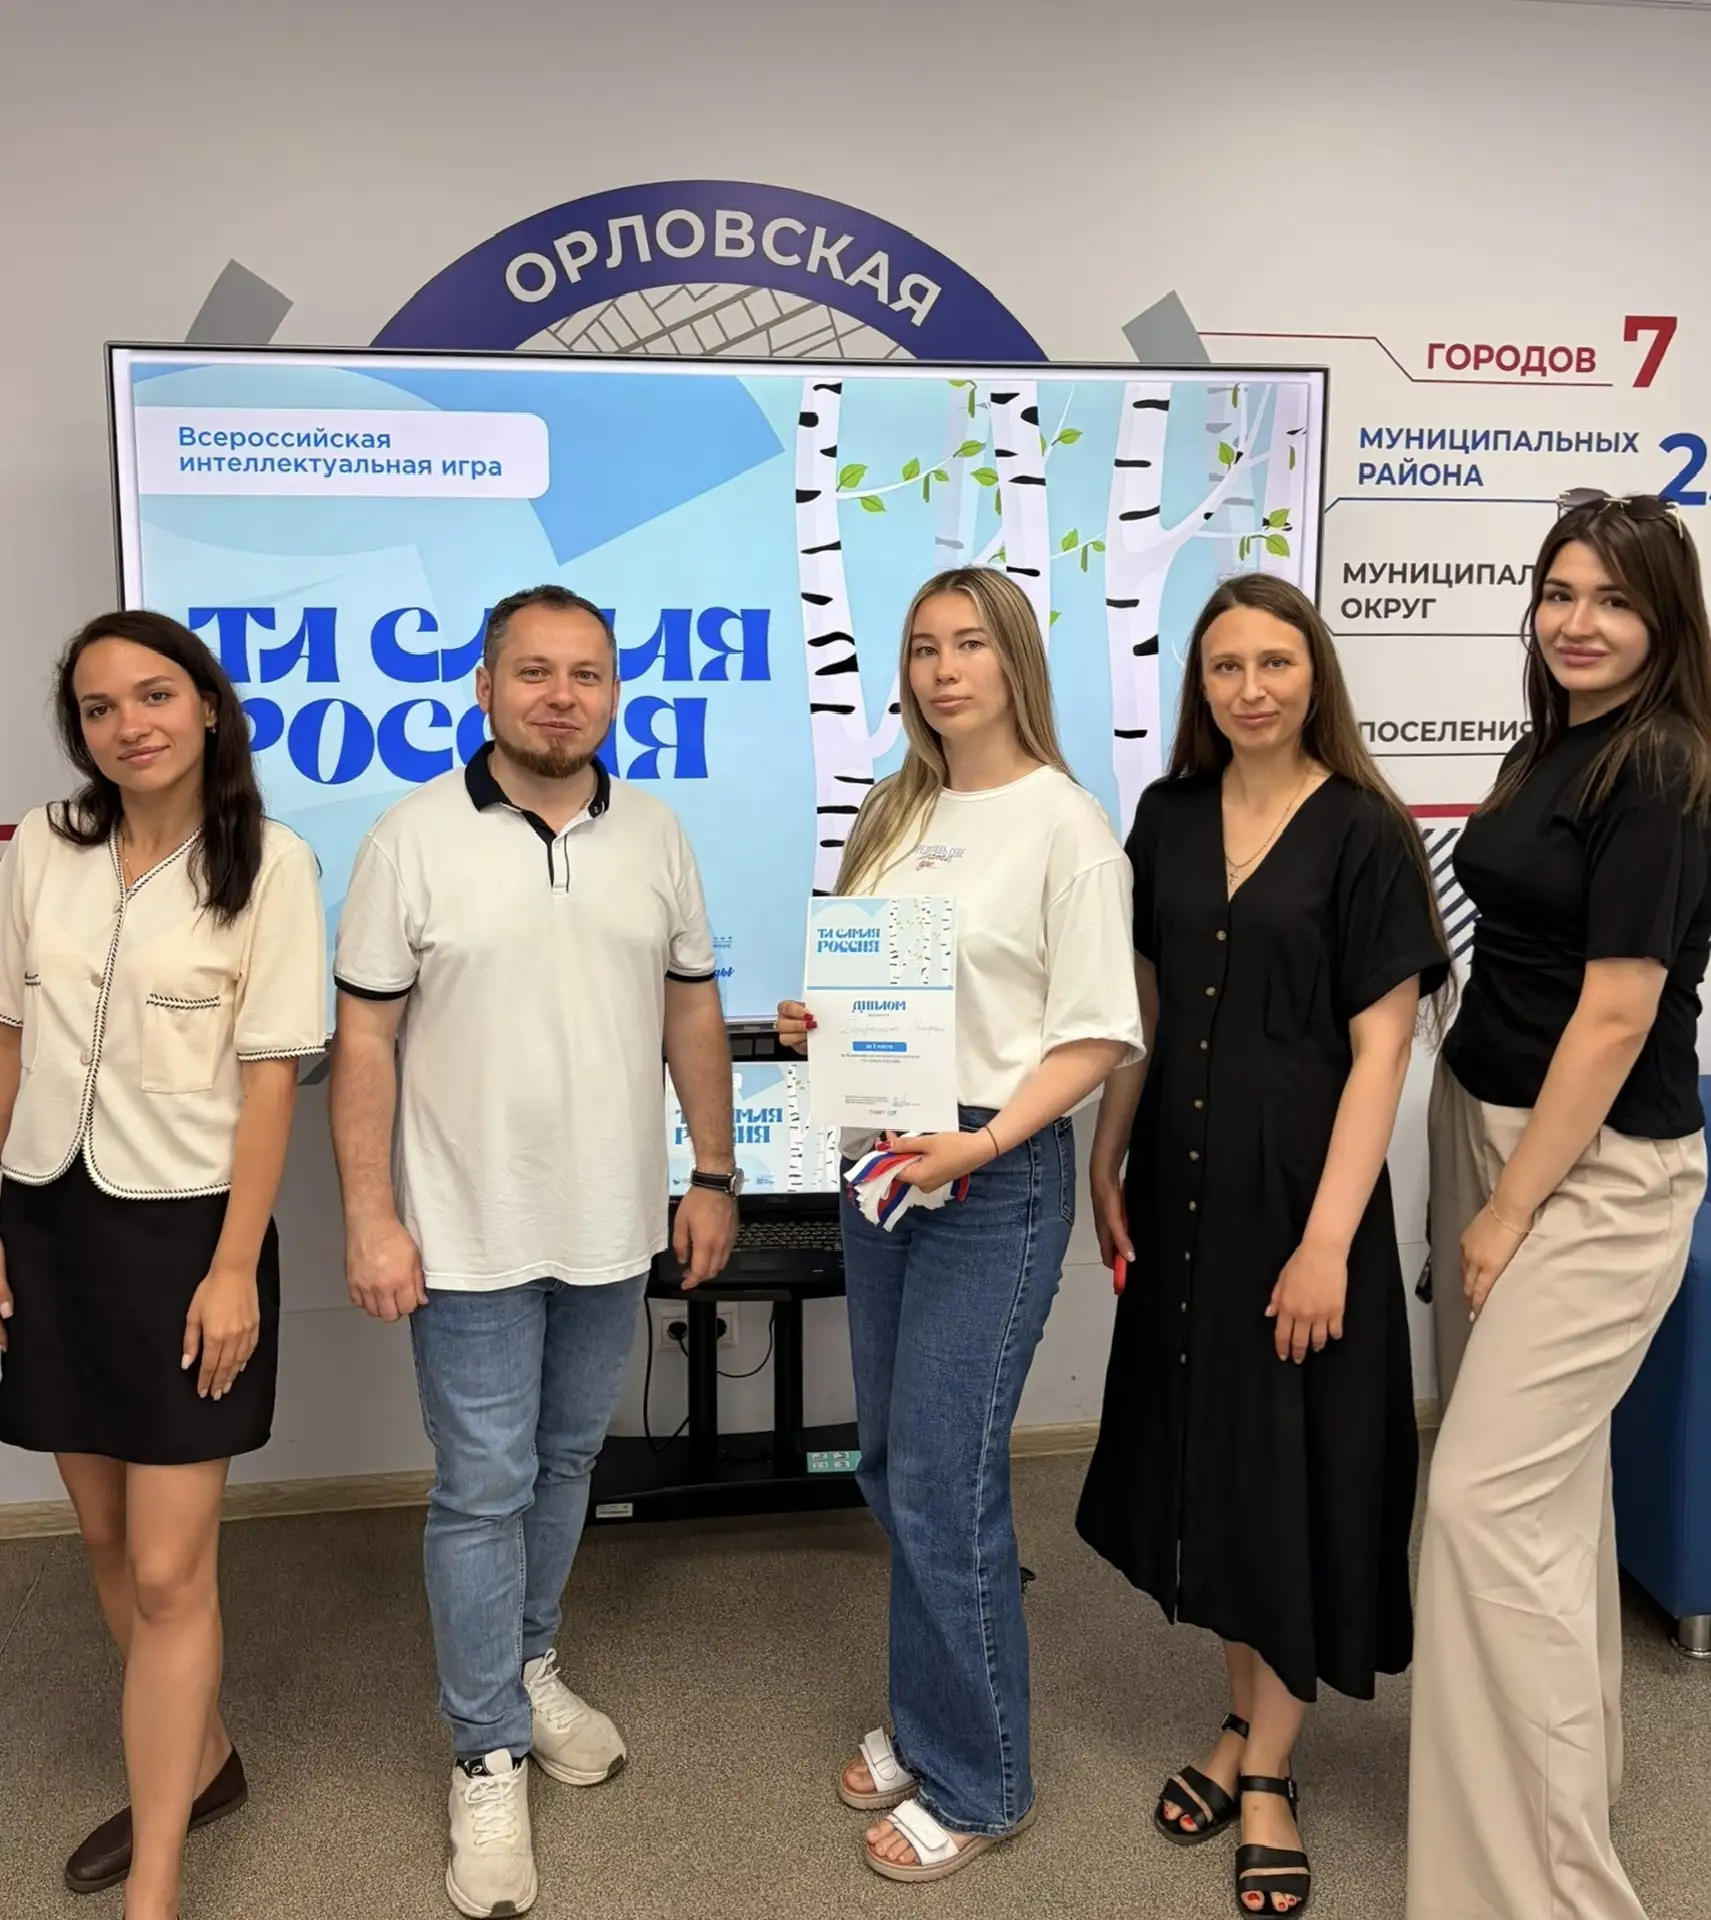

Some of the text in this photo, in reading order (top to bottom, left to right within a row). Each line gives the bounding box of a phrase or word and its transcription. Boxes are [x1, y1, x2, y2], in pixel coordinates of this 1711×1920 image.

[505, 208, 942, 327] ОРЛОВСКАЯ
[1427, 315, 1678, 388] ГОРОДОВ 7
[178, 426, 391, 450] Всероссийская
[179, 455, 502, 479] интеллектуальная игра
[1358, 457, 1484, 487] РАЙОНА
[1359, 427, 1711, 506] МУНИЦИПАЛЬНЫХ 2
[1340, 597, 1437, 620] ОКРУГ
[187, 606, 341, 684] ТА
[817, 940, 880, 953] РОССИЯ
[851, 1000, 907, 1014] ДИПЛОМ
